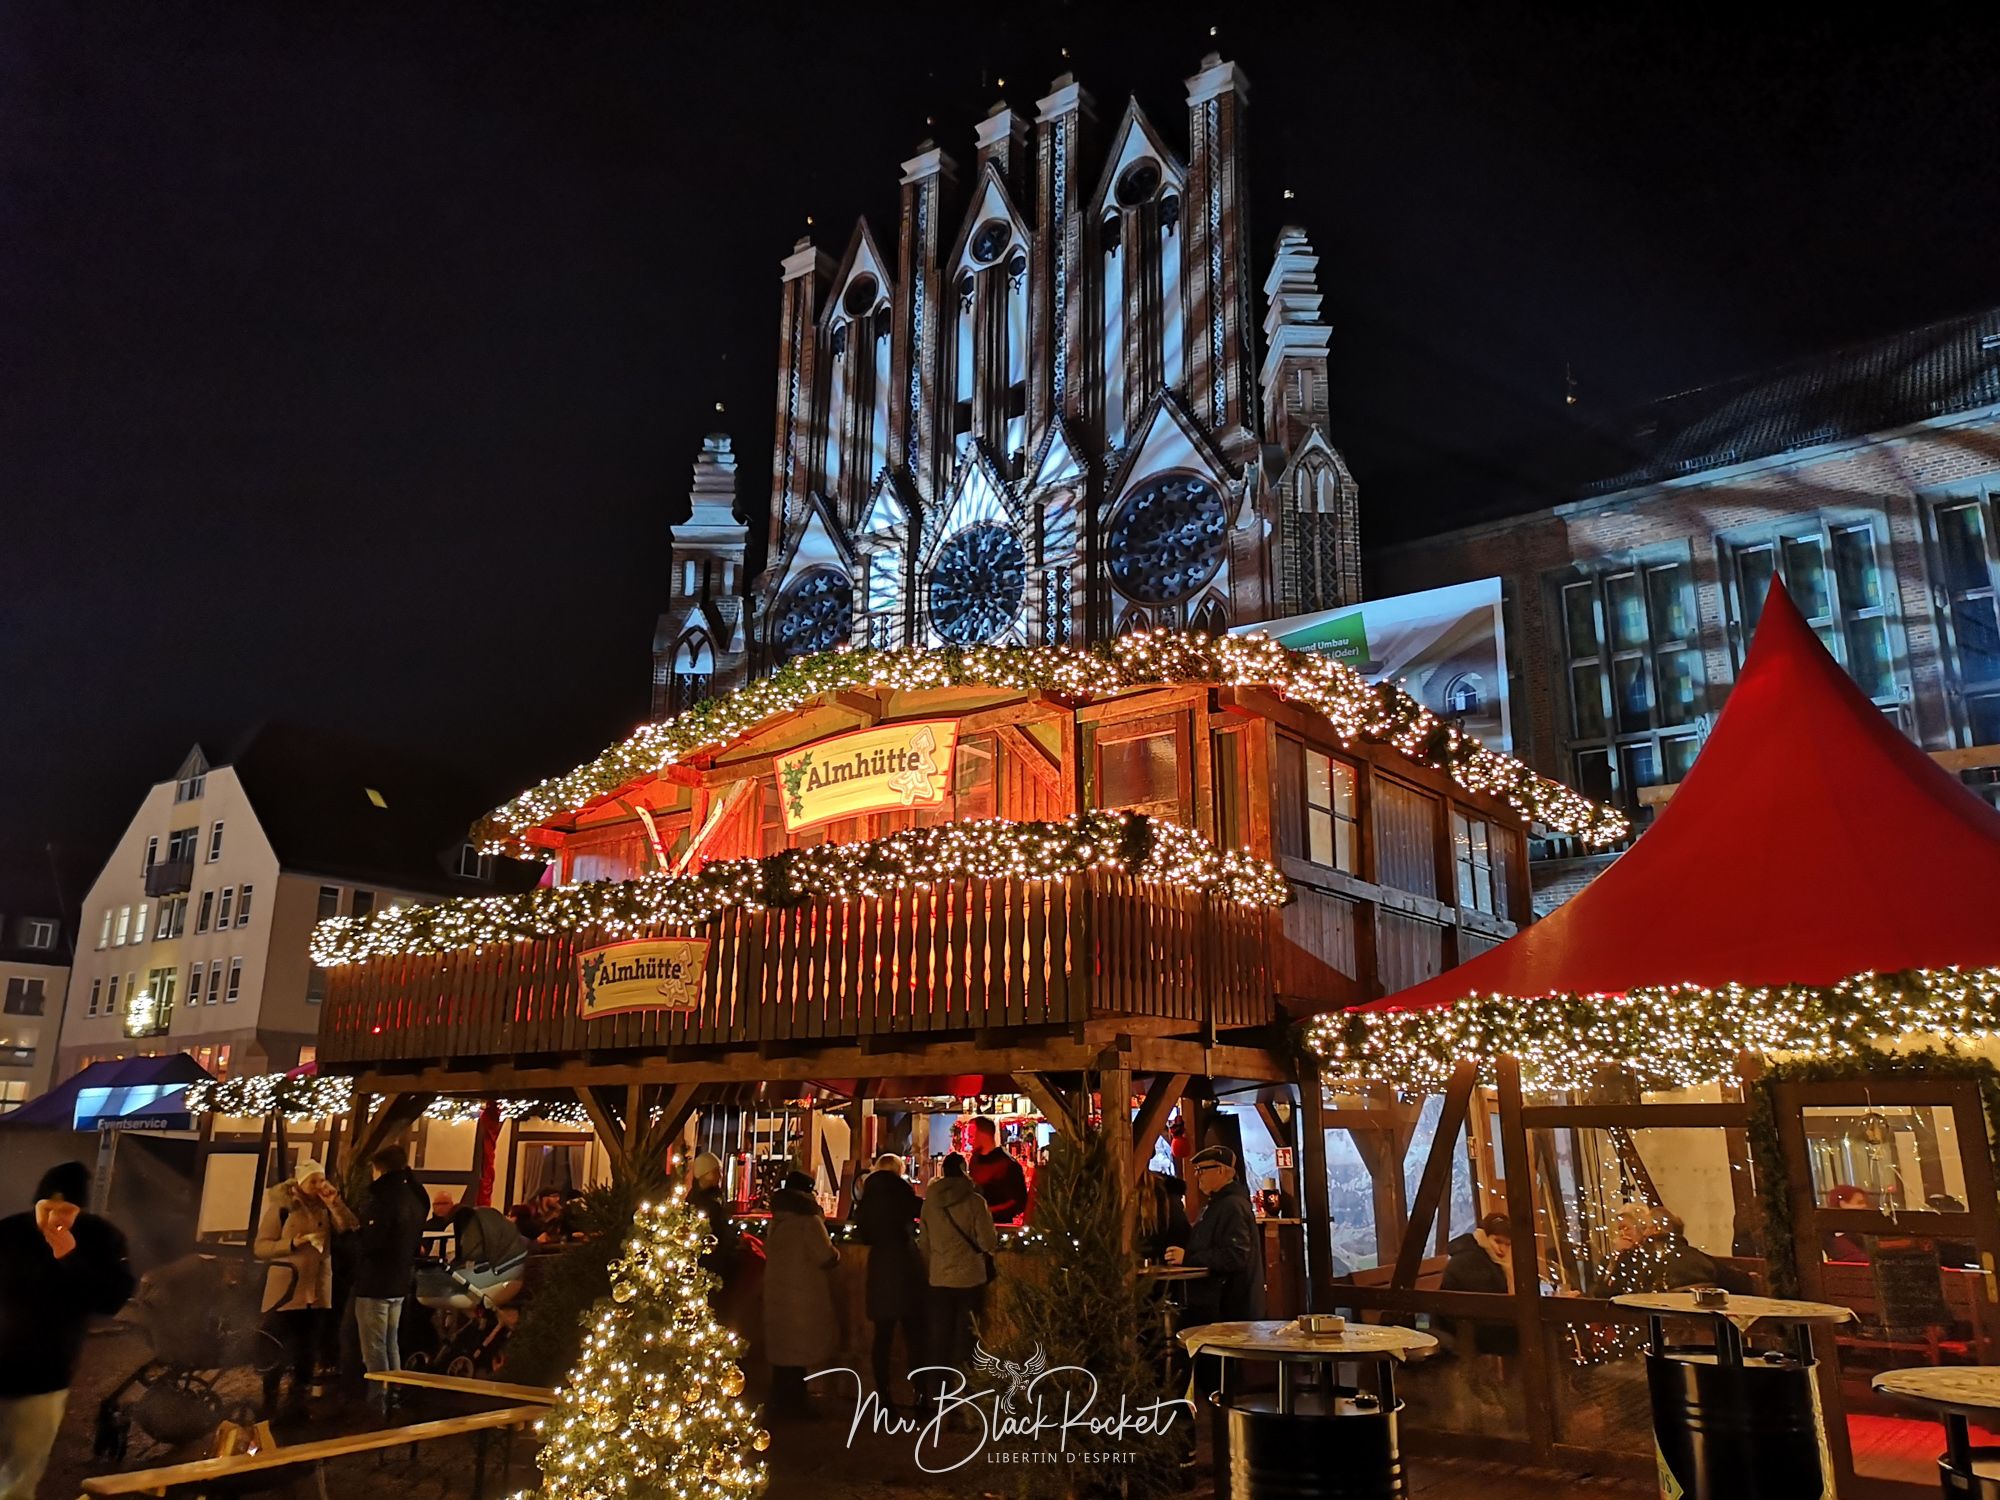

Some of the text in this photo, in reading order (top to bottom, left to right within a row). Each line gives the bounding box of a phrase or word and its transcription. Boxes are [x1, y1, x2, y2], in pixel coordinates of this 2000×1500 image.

[1317, 639, 1349, 650] Umbau
[1332, 647, 1359, 660] (Oder)
[806, 748, 921, 793] Almhütte
[598, 958, 681, 986] Almhütte
[97, 1117, 168, 1130] Eventservice
